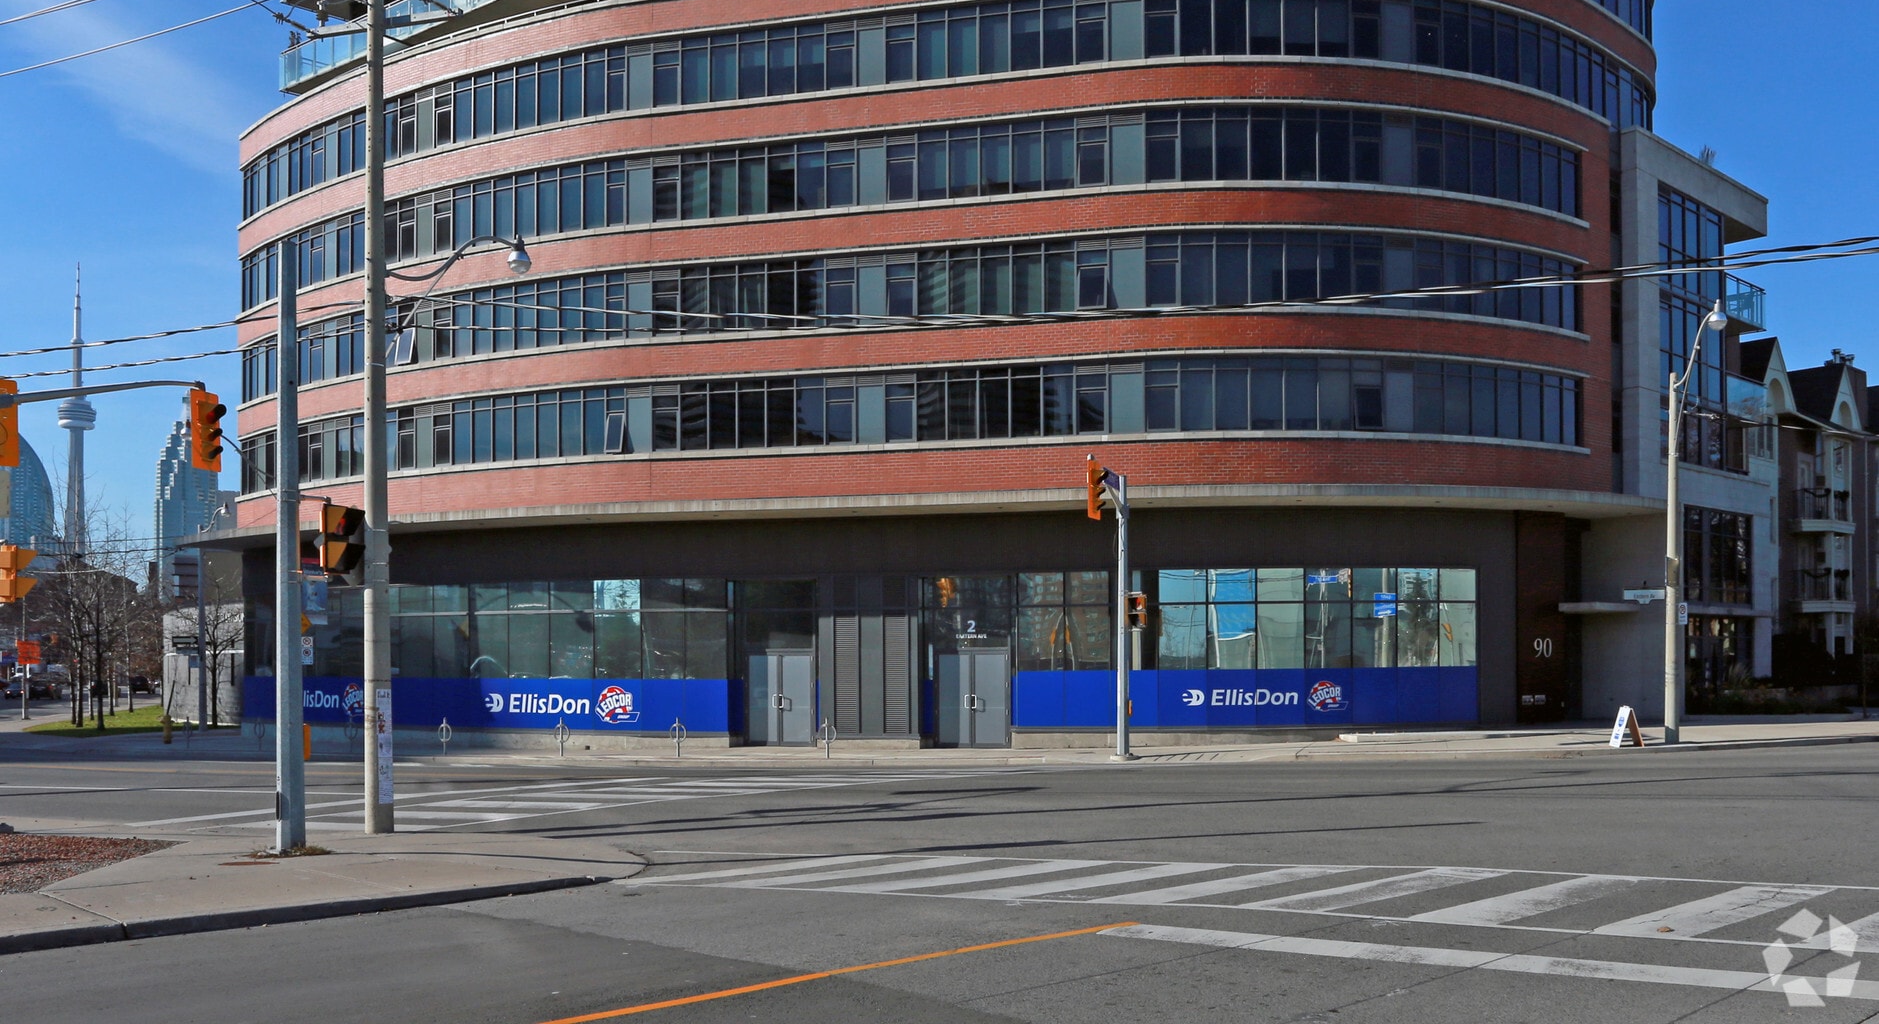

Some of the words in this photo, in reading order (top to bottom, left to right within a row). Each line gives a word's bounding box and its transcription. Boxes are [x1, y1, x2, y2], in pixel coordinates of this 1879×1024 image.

[967, 620, 976, 633] 2
[1534, 638, 1552, 658] 90
[303, 690, 340, 708] lisDon
[509, 693, 590, 715] EllisDon
[596, 693, 632, 718] LEDCOR
[1211, 689, 1299, 706] EllisDon
[1308, 686, 1341, 707] LEDCOR
